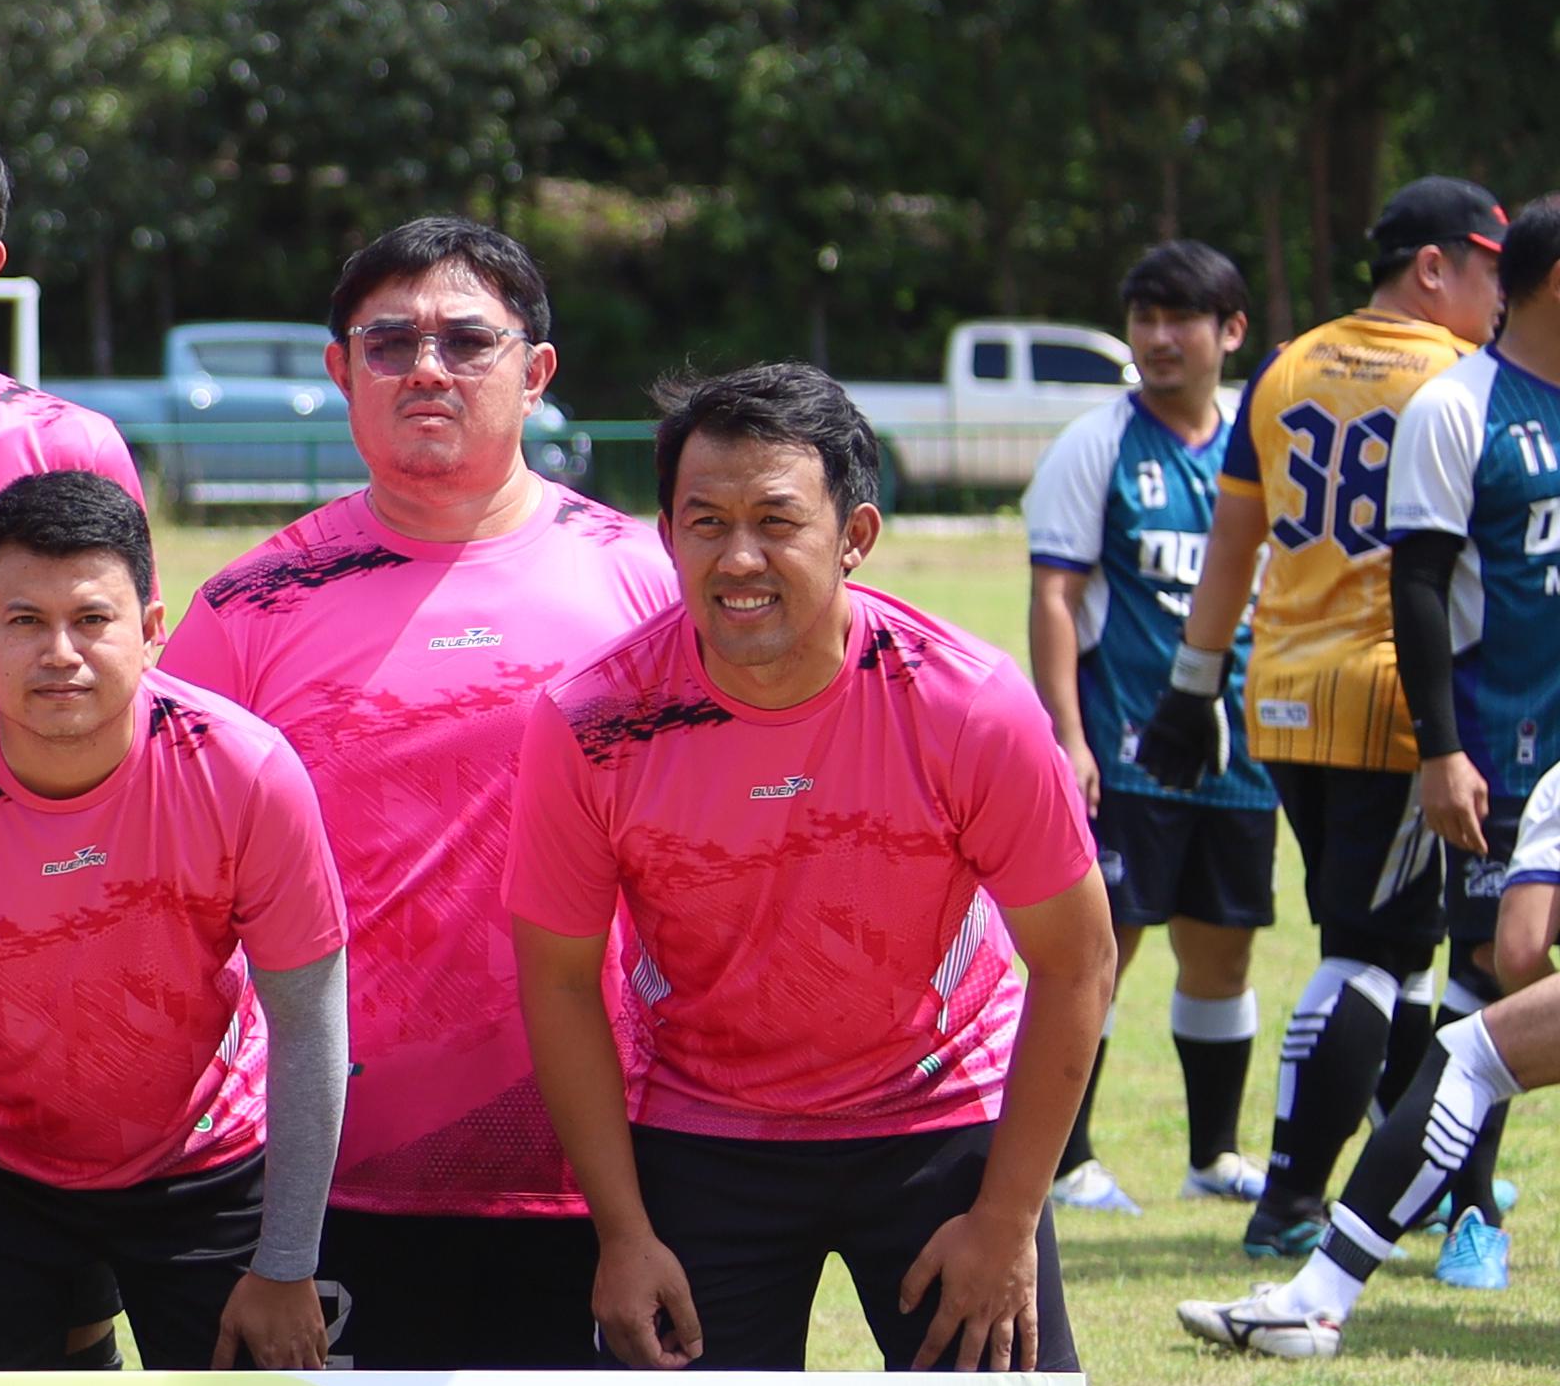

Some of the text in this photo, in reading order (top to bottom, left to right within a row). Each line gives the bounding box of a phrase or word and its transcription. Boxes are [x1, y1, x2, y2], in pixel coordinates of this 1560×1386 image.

[1509, 419, 1559, 477] 11
[1272, 399, 1399, 562] 38
[428, 634, 503, 650] BLUEMAN
[750, 777, 814, 799] BLUEMN
